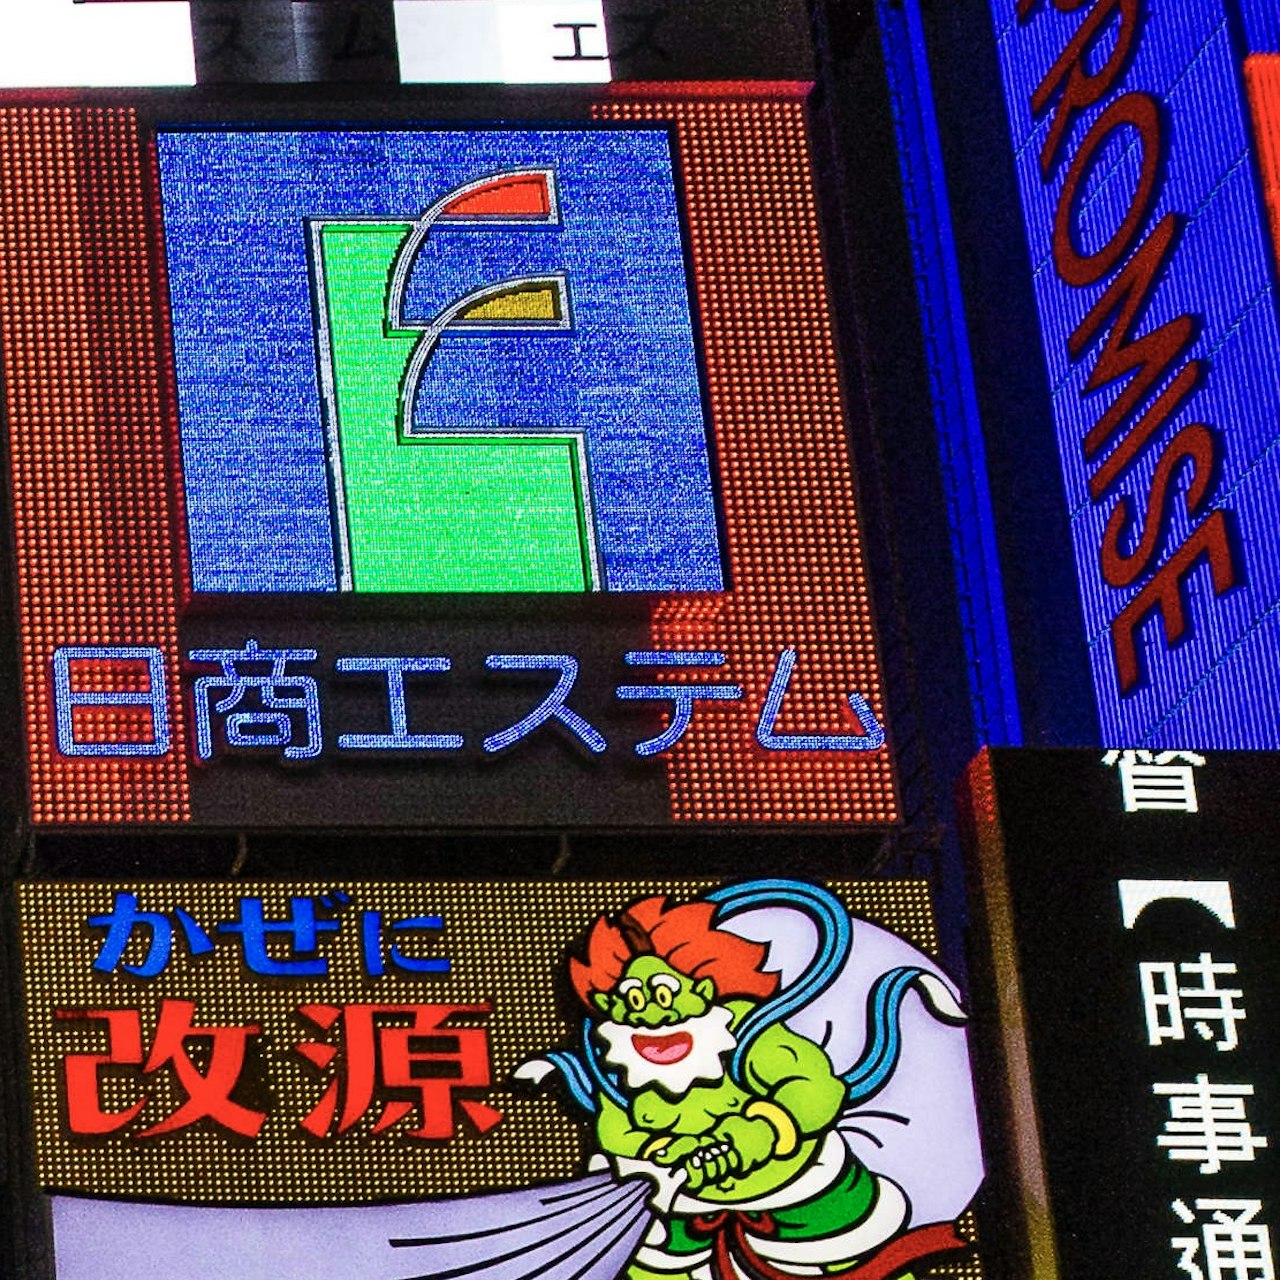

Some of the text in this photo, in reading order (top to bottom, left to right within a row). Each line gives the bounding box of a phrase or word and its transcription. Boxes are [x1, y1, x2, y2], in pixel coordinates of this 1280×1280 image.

[1020, 0, 1237, 697] ROMISE
[53, 638, 887, 760] 日商エステム
[87, 889, 452, 980] かぜに
[52, 998, 504, 1142] 改源
